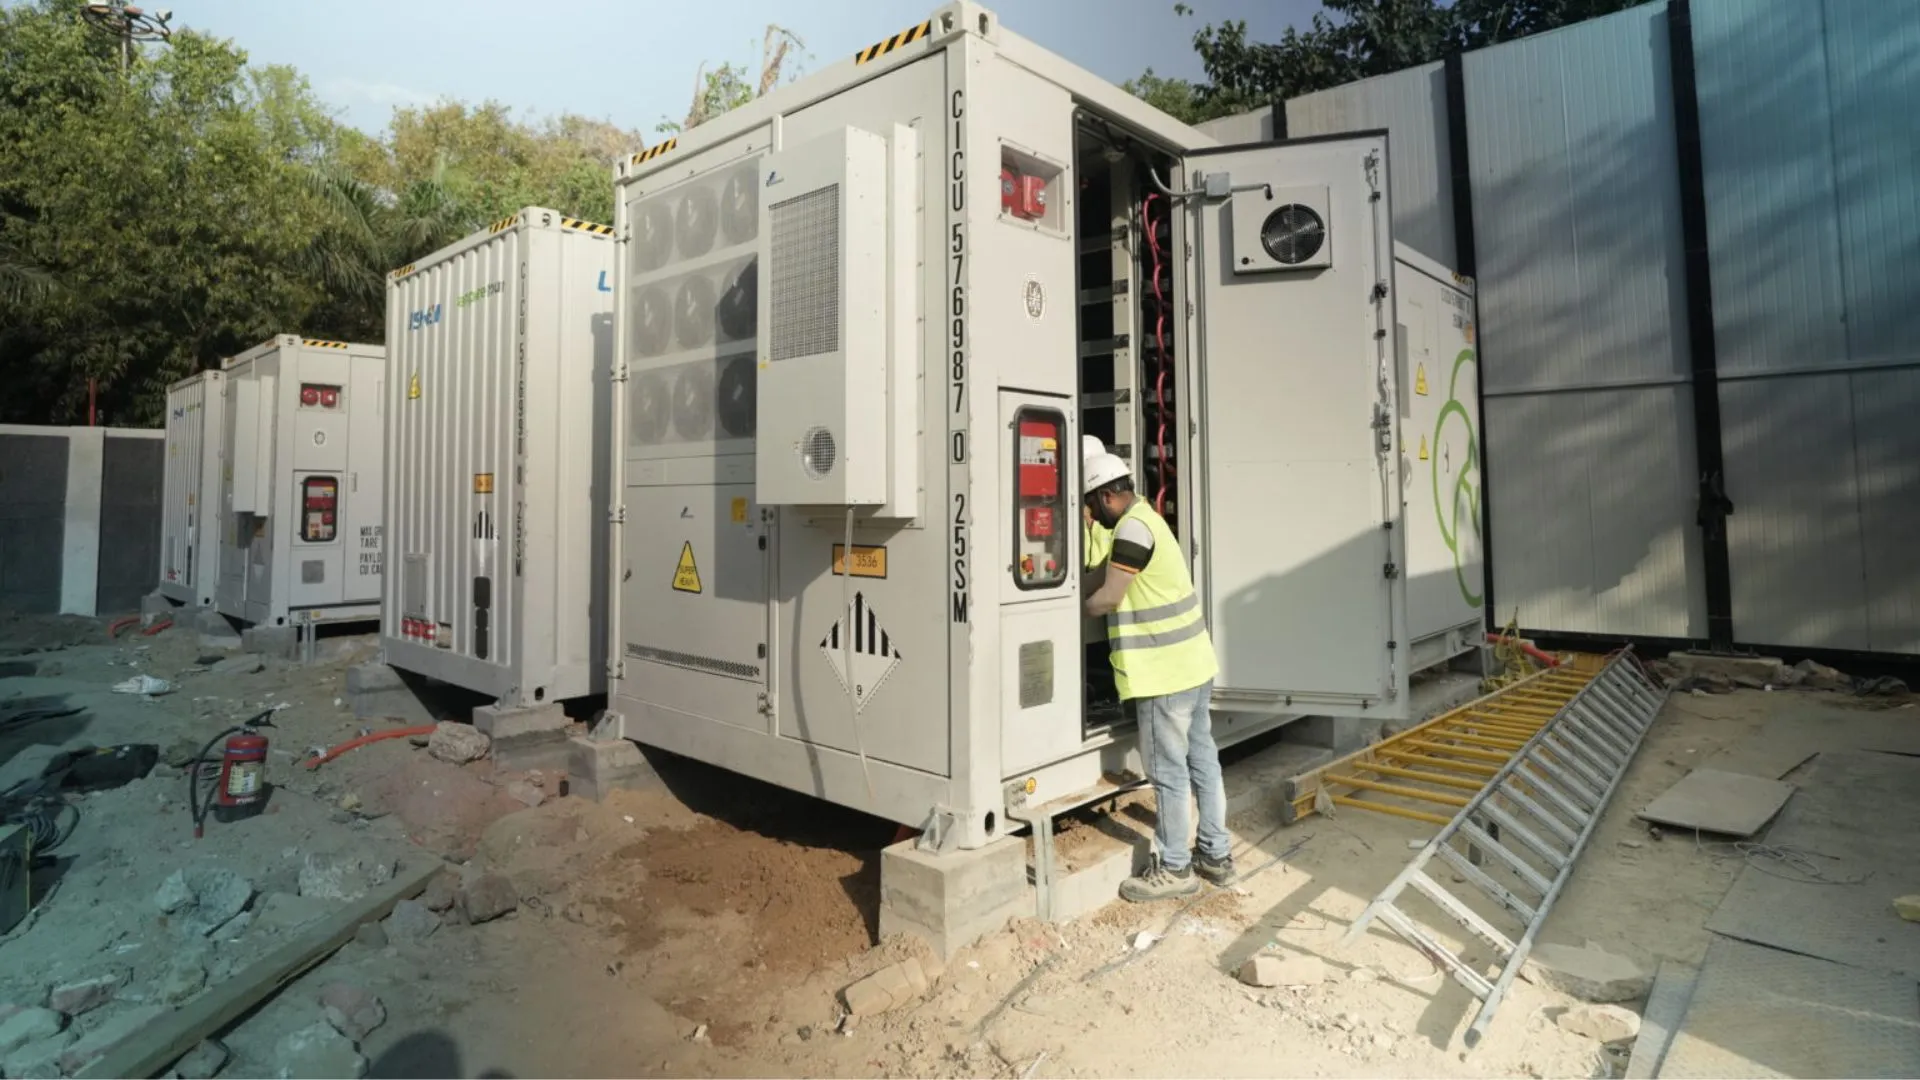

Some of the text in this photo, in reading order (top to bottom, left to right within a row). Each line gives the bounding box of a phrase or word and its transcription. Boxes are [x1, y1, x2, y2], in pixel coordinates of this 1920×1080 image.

[952, 89, 968, 624] CICU 576987 0 25SM
[856, 553, 878, 569] 3536
[856, 684, 862, 696] 9
